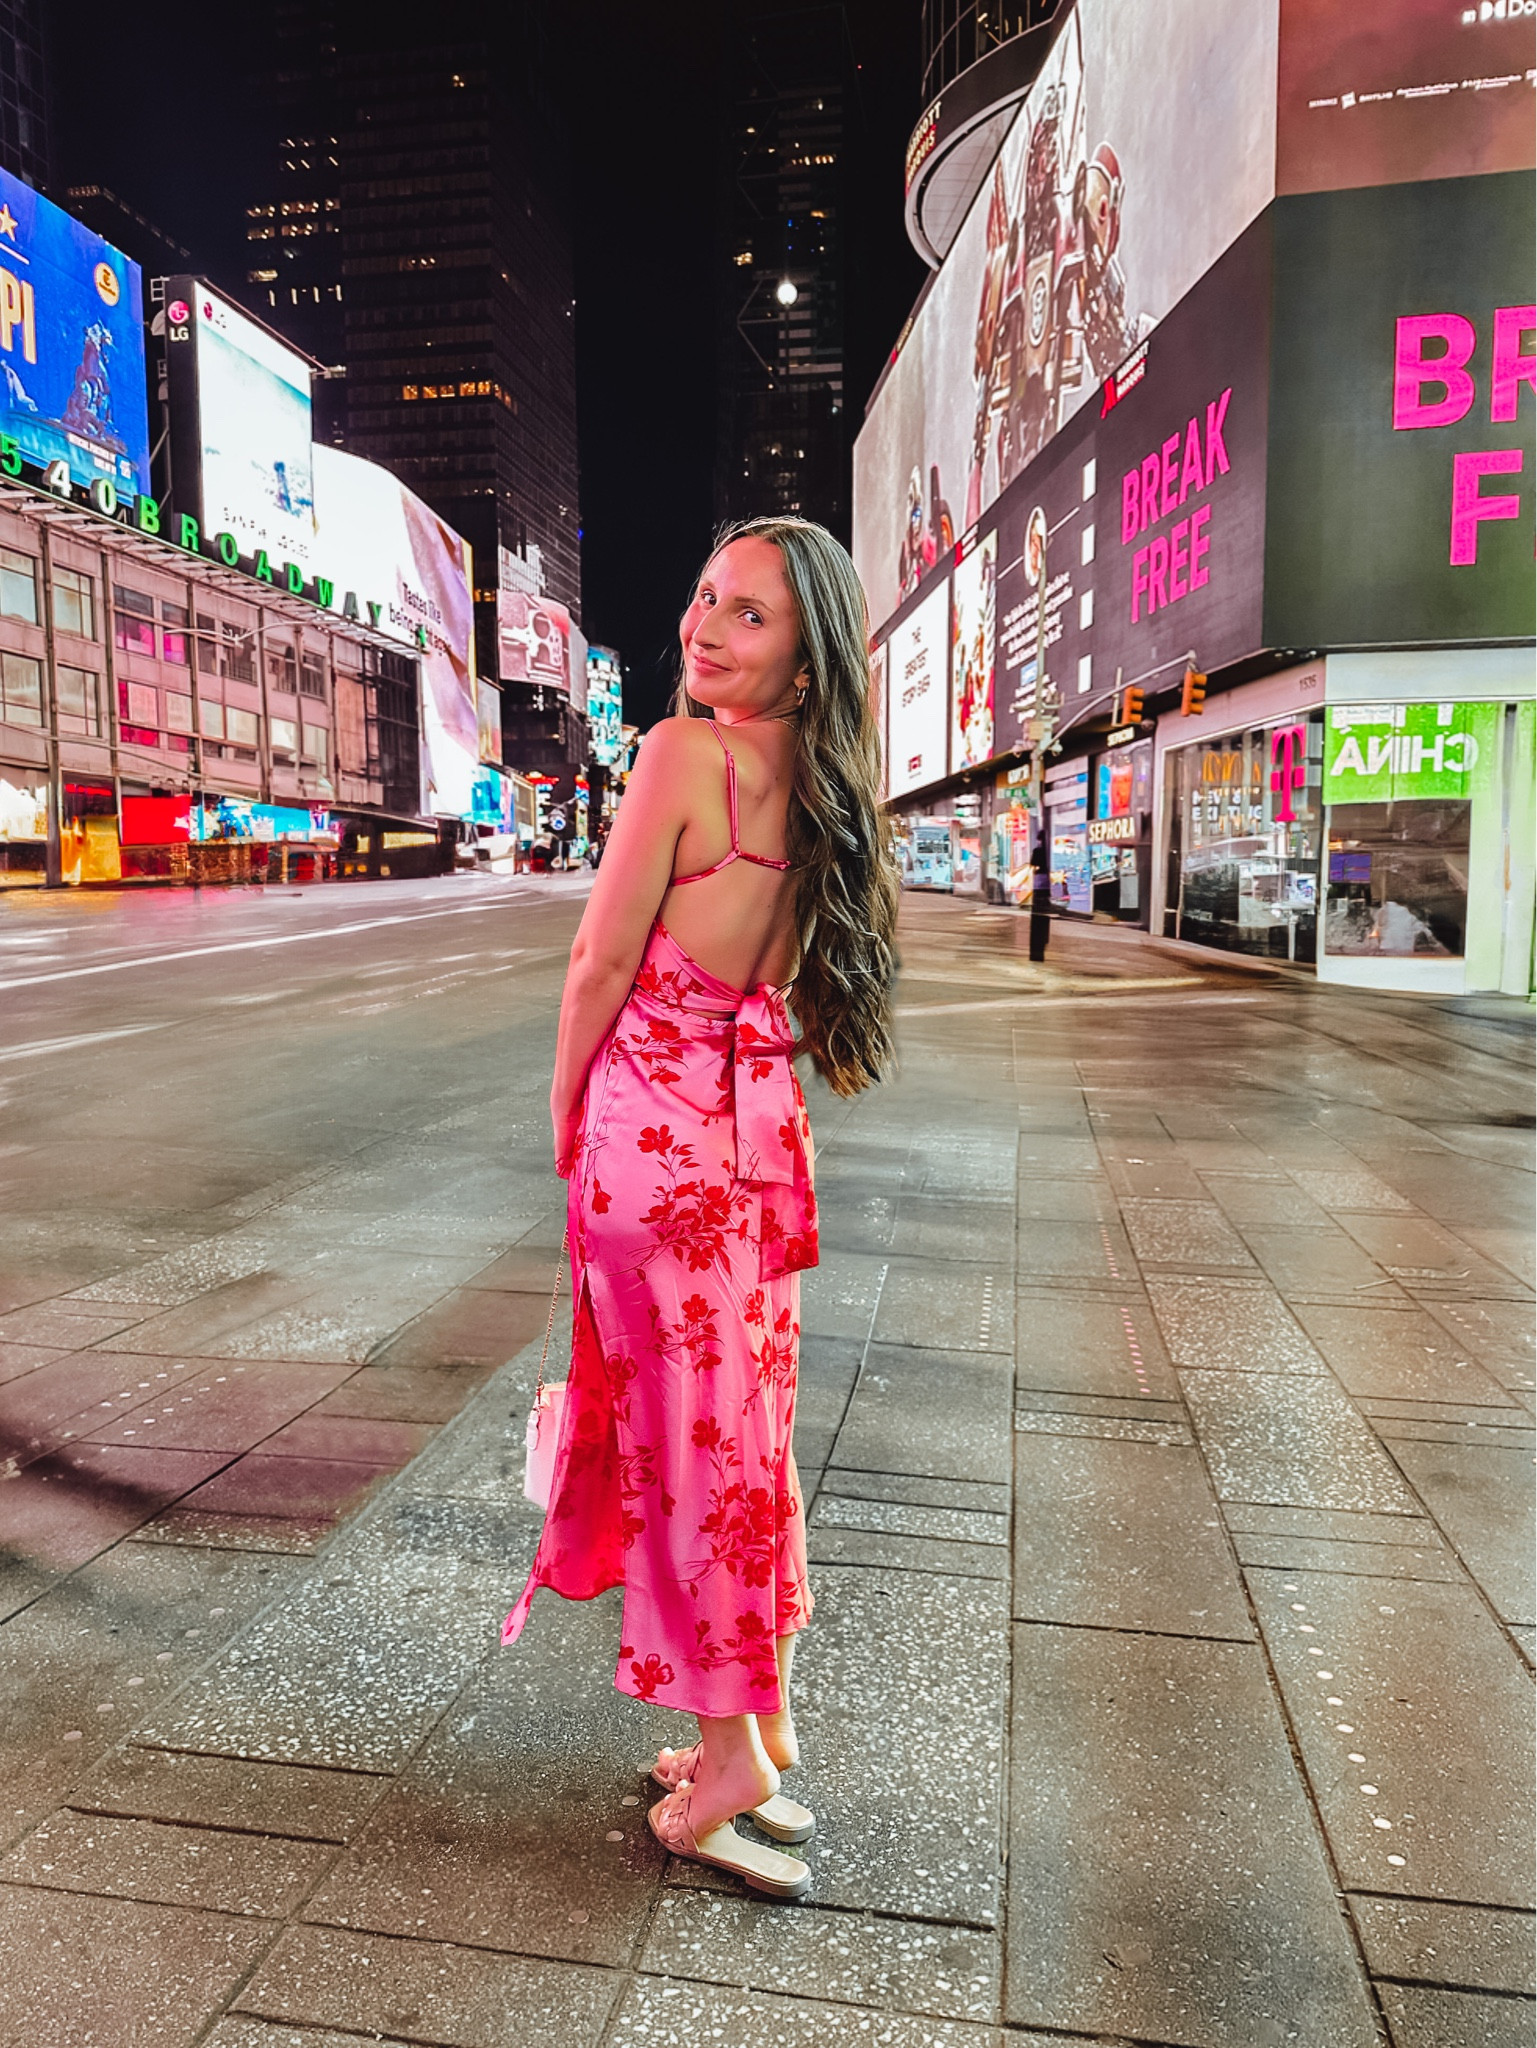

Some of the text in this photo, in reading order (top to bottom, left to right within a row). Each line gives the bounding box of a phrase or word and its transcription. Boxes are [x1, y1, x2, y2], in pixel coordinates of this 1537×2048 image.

[170, 328, 189, 342] LG
[1121, 387, 1233, 546] BREAK
[1450, 449, 1536, 566] F
[136, 493, 382, 628] BROADWAY
[1131, 503, 1212, 625] FREE
[402, 582, 427, 616] Tastes
[1088, 816, 1136, 842] SEPHORA
[1191, 805, 1263, 821] EXITIG
